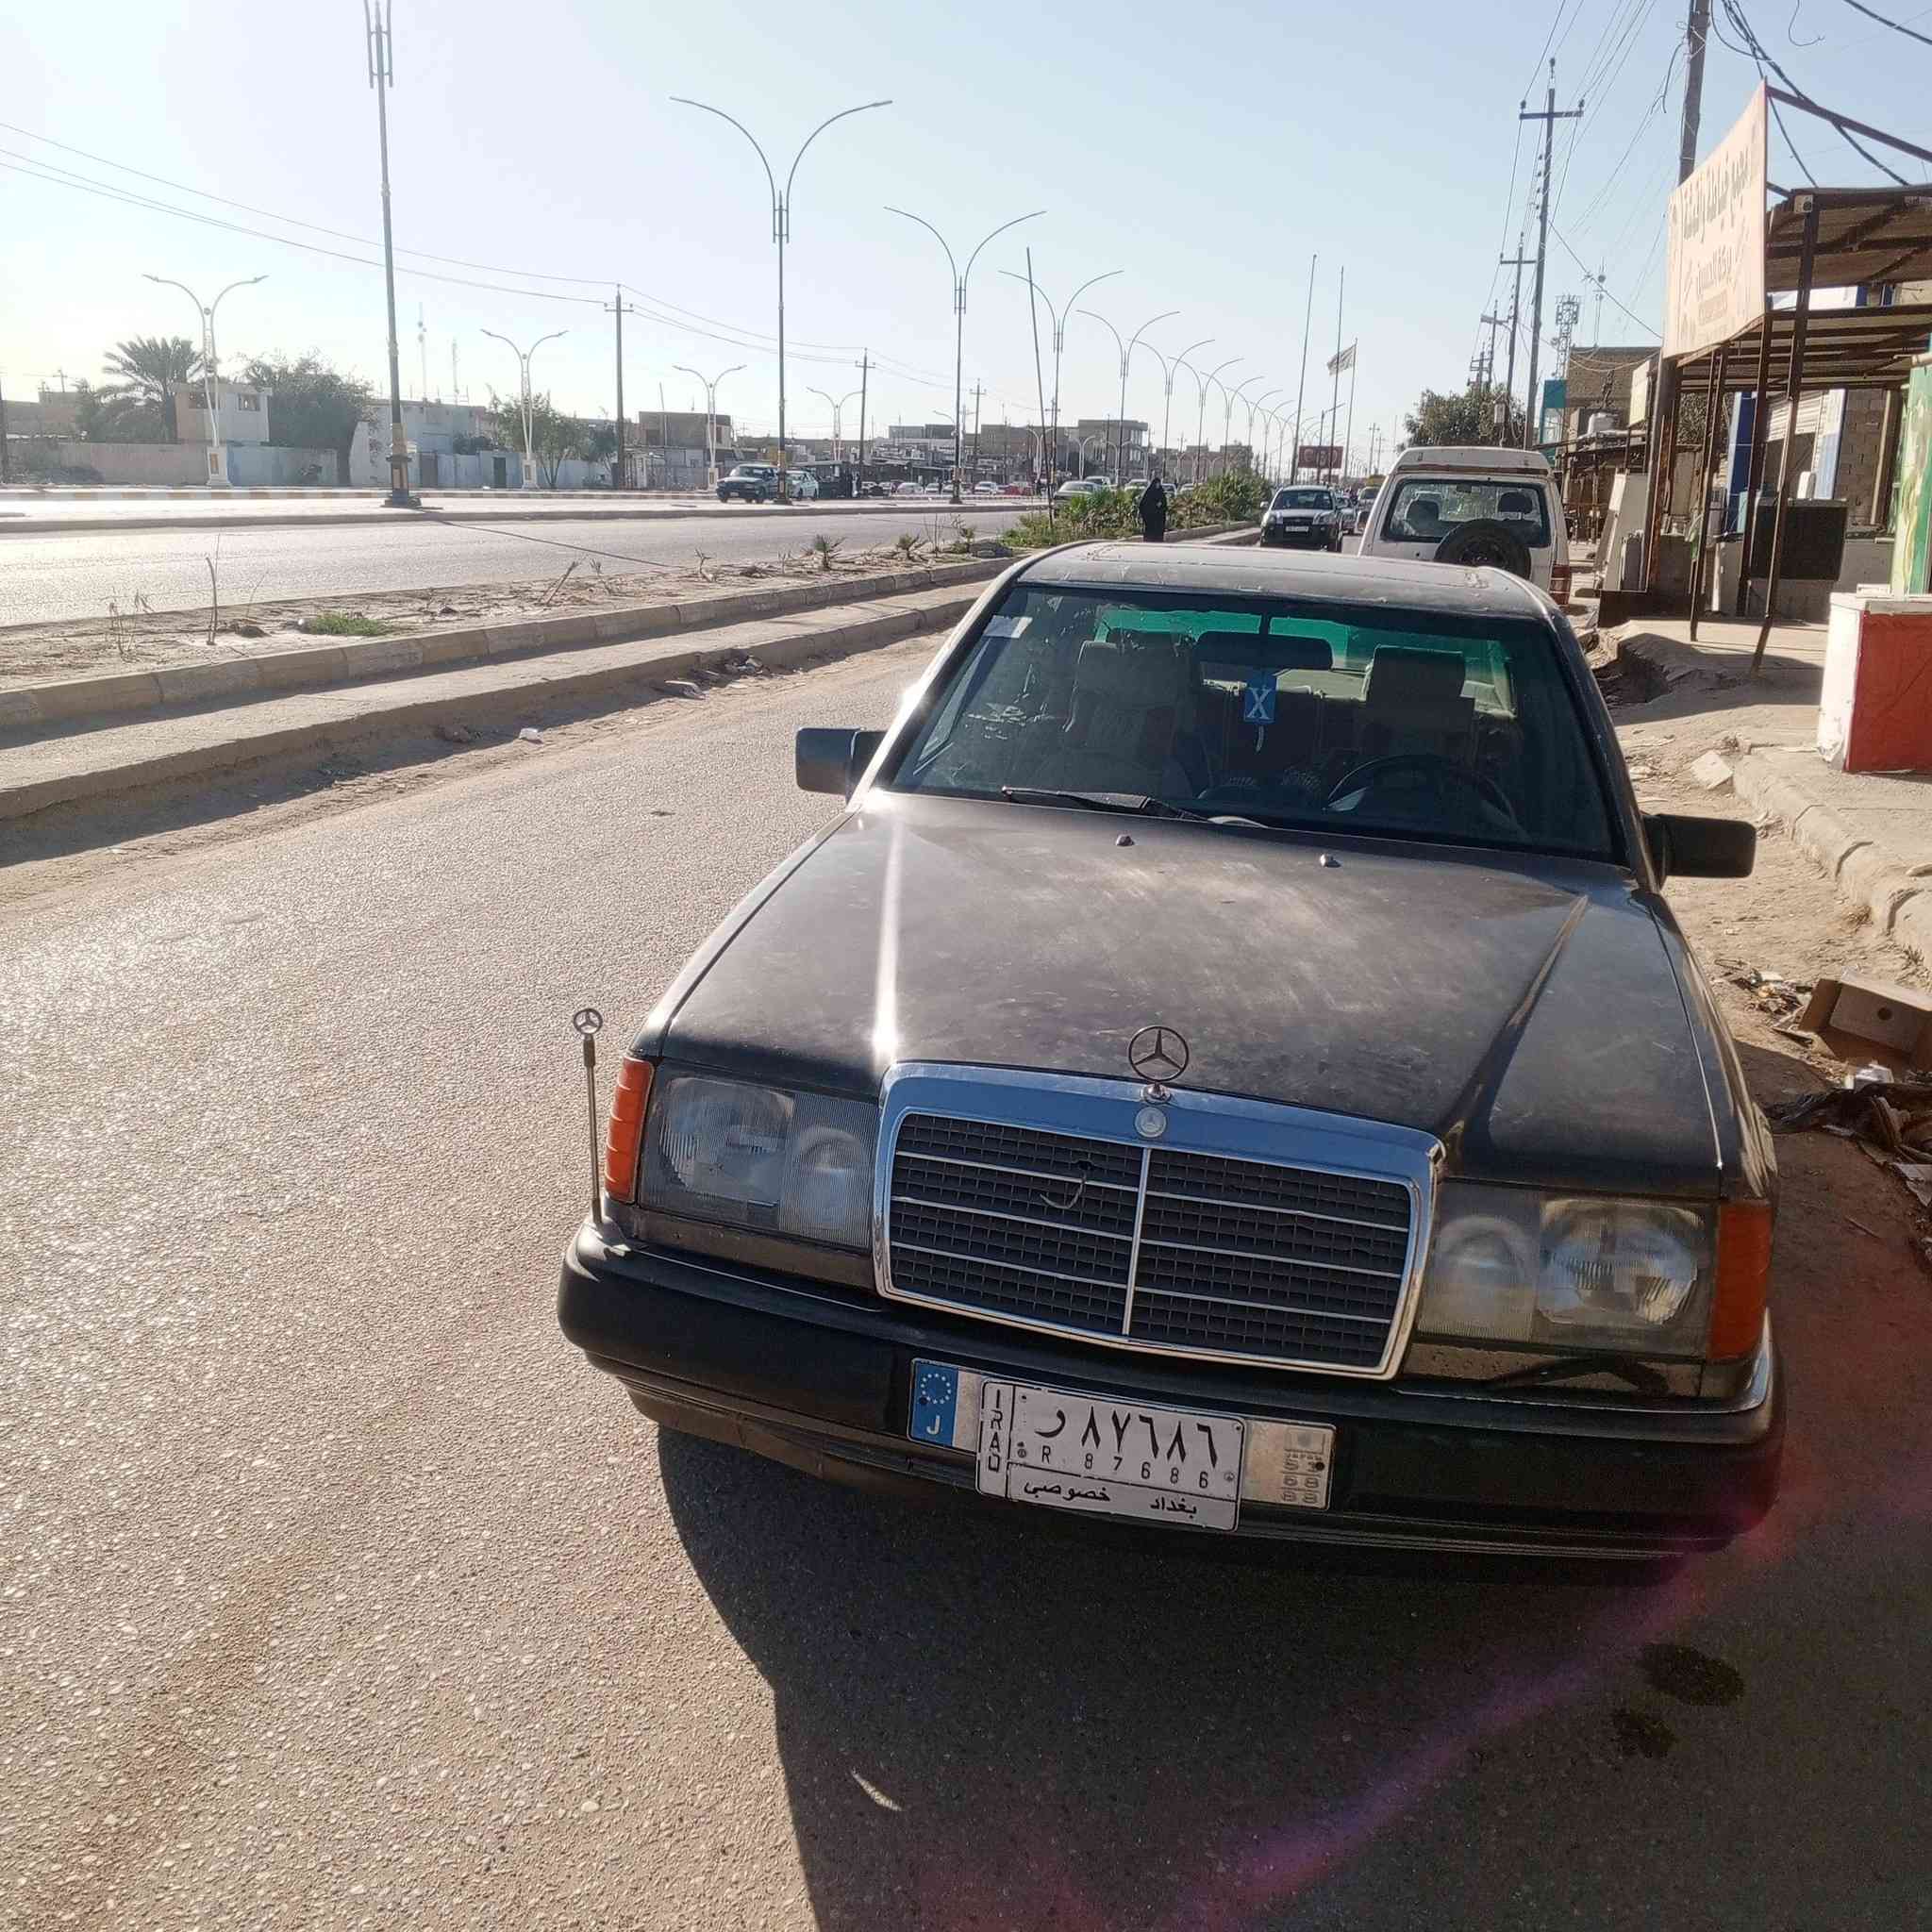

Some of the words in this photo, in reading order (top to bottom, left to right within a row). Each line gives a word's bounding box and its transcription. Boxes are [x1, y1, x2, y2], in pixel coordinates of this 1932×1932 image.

[1041, 1445, 1052, 1463] R
[1084, 1453, 1208, 1489] 87686
[1149, 1496, 1198, 1520] بغداد
